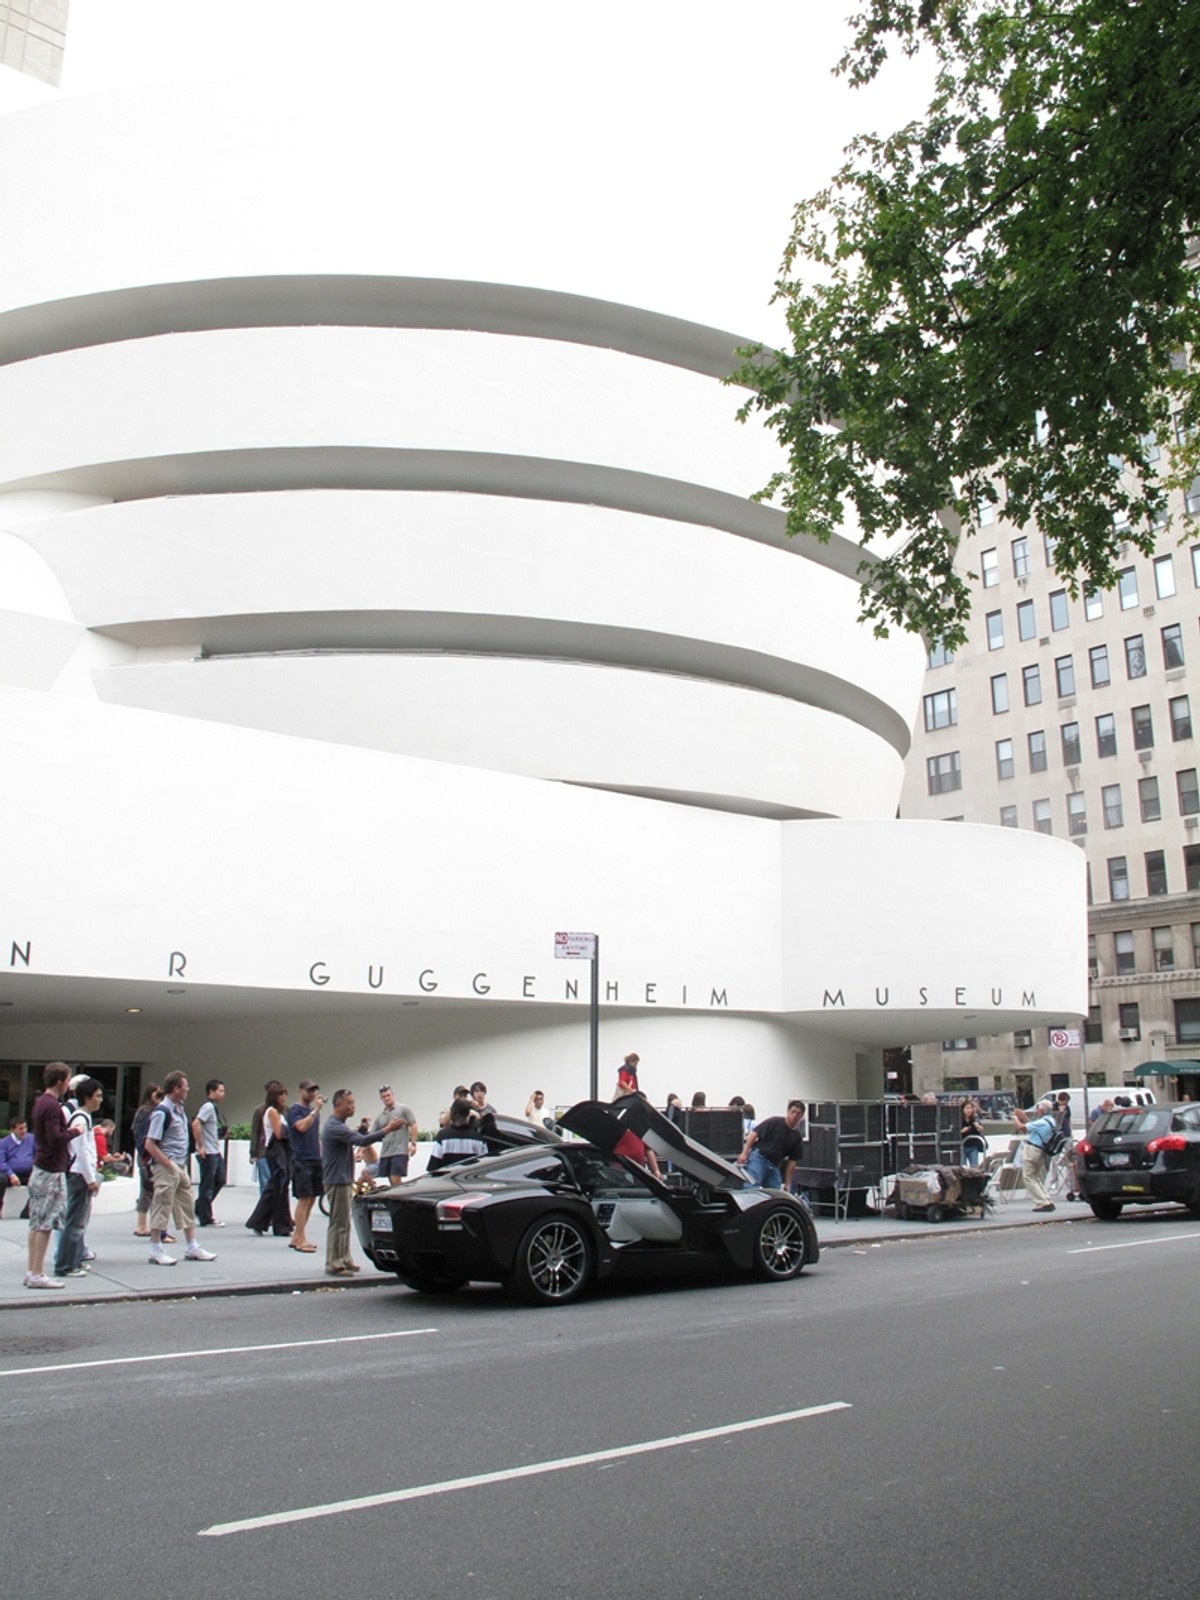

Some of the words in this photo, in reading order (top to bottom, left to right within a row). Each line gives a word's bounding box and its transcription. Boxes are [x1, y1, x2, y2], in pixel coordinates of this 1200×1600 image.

[556, 933, 568, 944] NO
[168, 951, 188, 978] R
[309, 961, 728, 1006] GUGGENHEIM
[822, 987, 1036, 1007] MUSEUM
